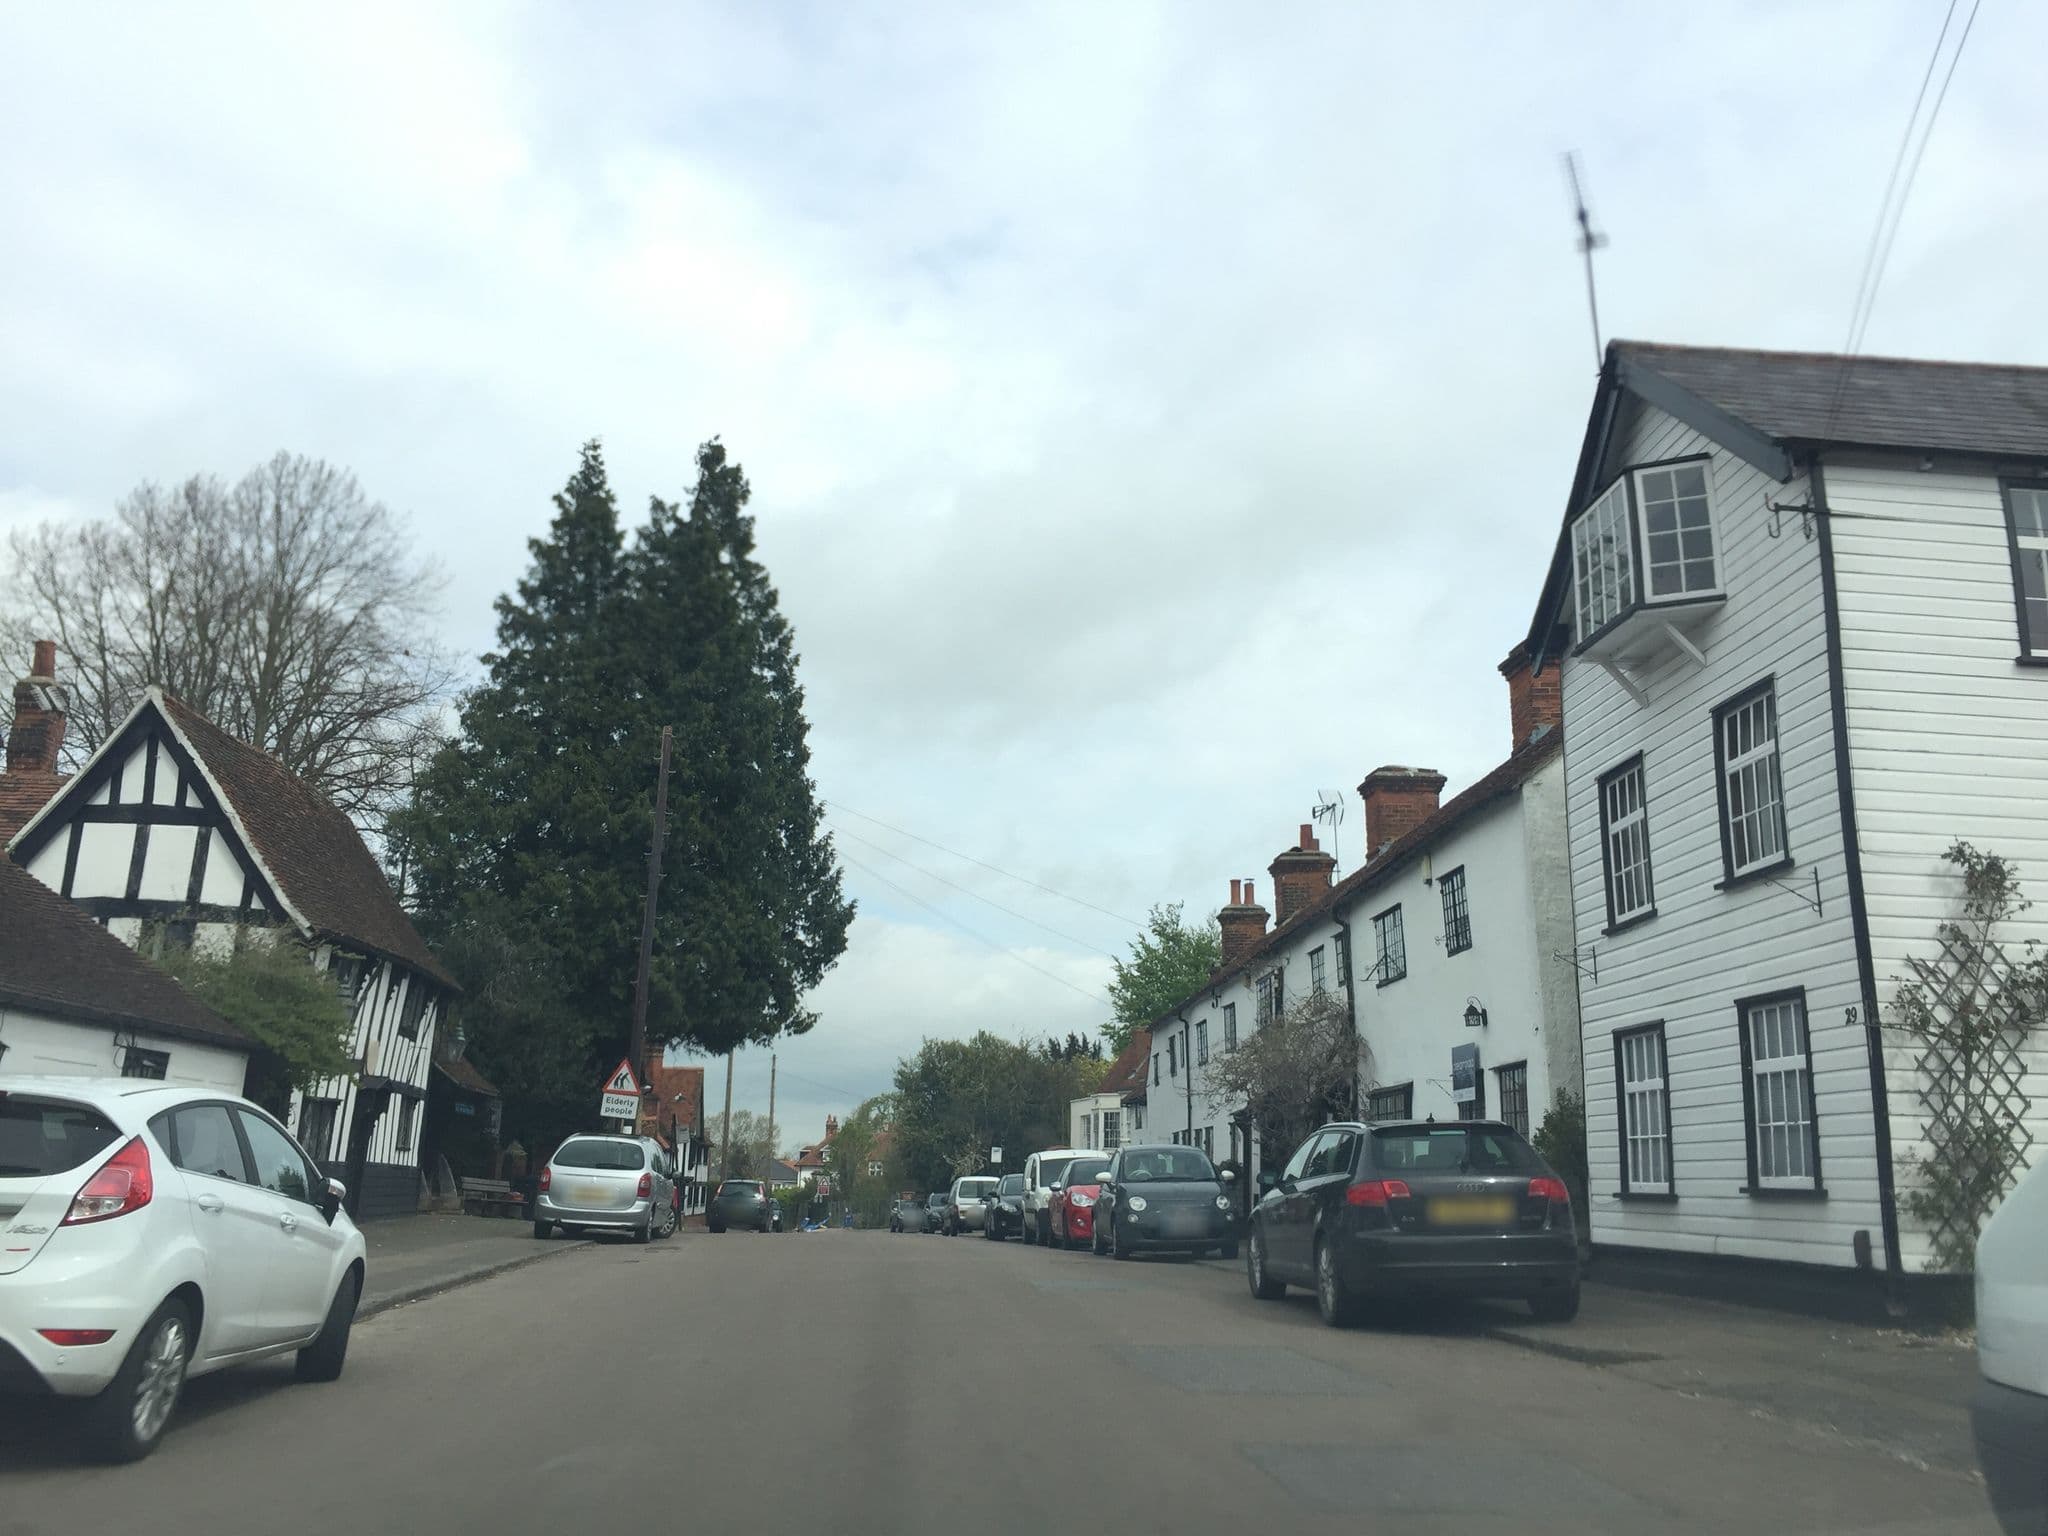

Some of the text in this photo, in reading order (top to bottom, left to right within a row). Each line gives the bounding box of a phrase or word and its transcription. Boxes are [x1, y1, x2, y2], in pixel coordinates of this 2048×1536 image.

[1845, 1006, 1857, 1025] 29
[606, 1096, 634, 1107] Elderly
[605, 1106, 632, 1115] people
